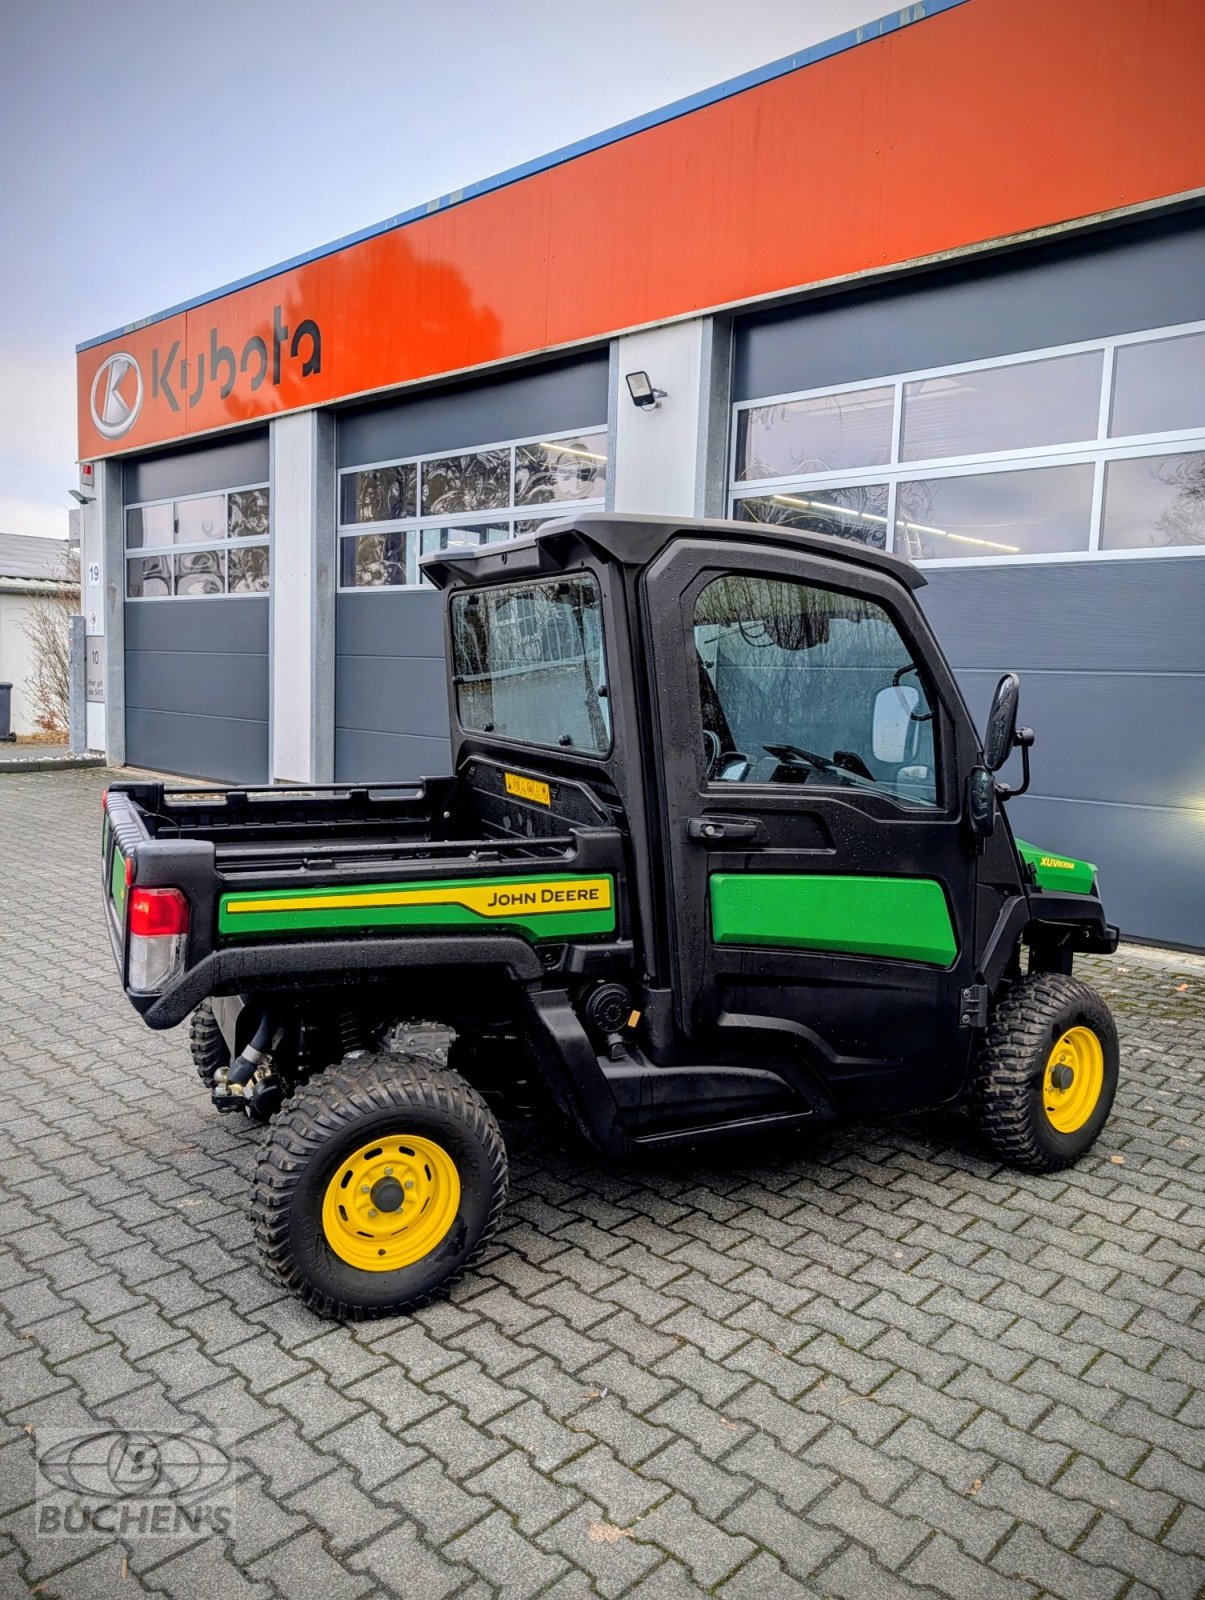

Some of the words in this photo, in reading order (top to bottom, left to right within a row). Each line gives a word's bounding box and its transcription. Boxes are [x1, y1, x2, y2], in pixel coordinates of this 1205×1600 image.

[152, 305, 322, 413] Kubota
[90, 566, 99, 581] 19
[92, 650, 99, 665] 10
